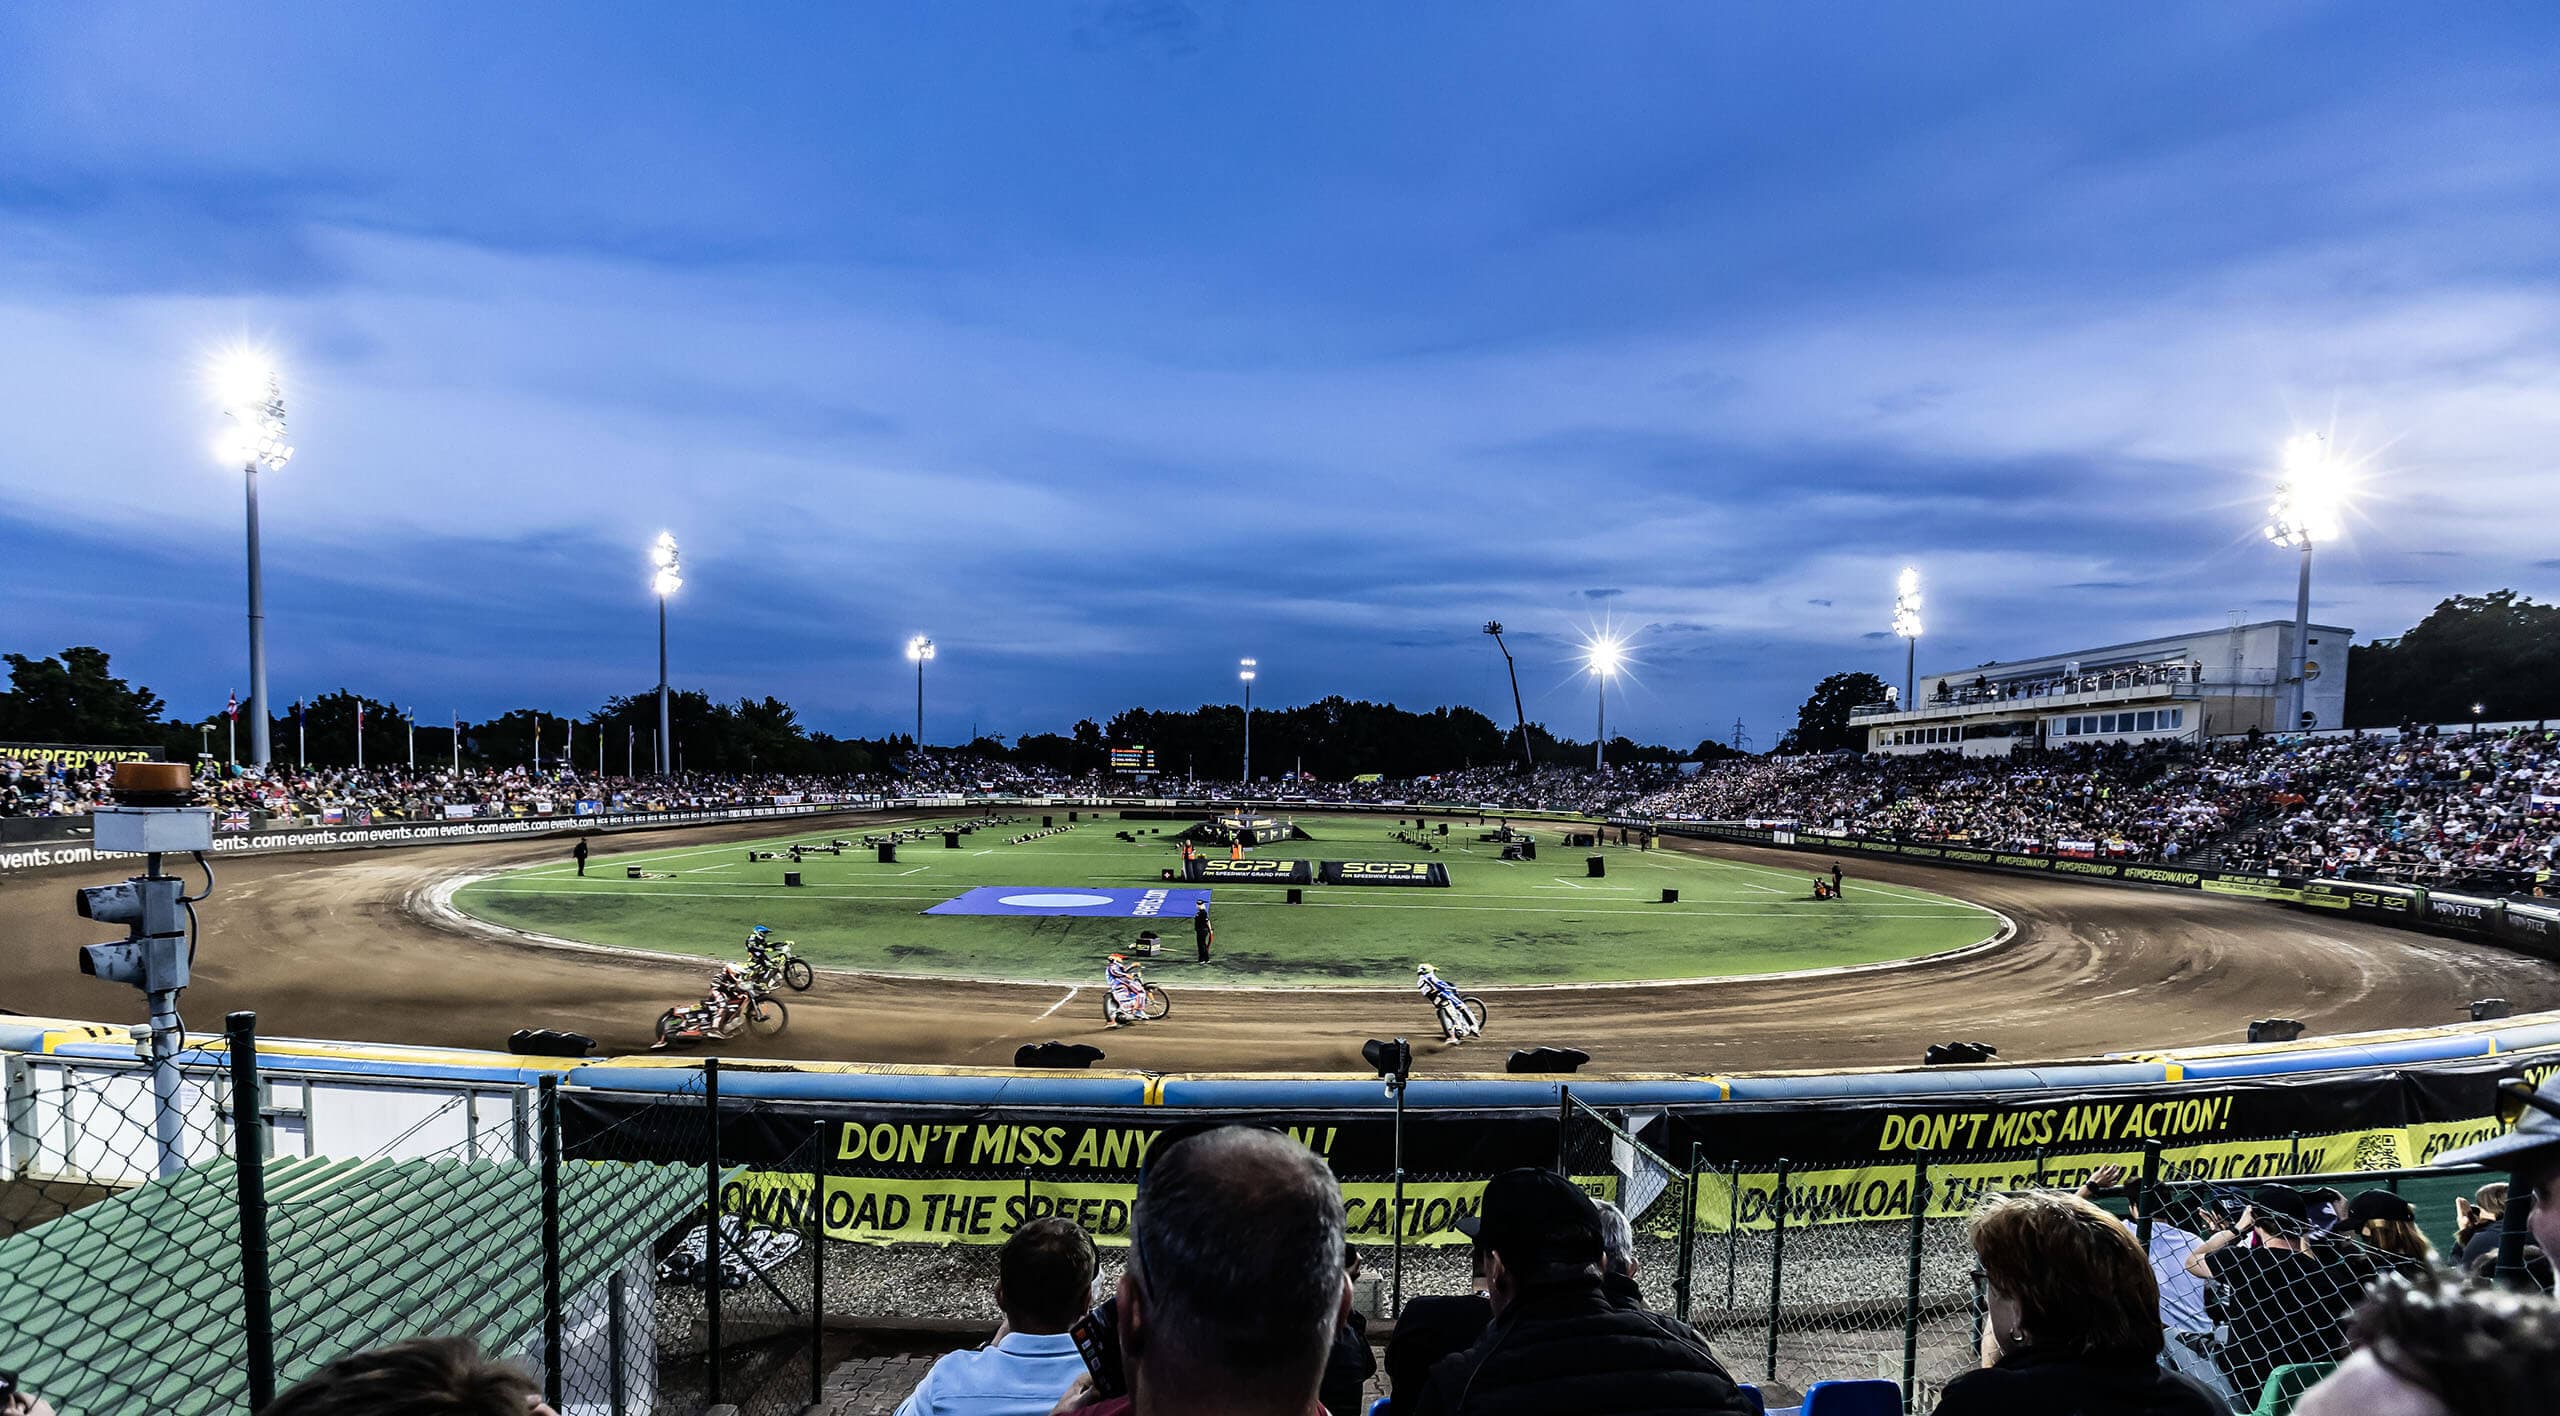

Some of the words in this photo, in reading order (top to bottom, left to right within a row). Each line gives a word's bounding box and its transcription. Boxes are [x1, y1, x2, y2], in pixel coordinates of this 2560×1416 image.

[213, 835, 286, 851] ents.com
[288, 831, 370, 847] events.com
[370, 827, 439, 842] events.com
[440, 823, 499, 837] events.com
[499, 820, 550, 833] events.com
[1204, 860, 1277, 872] SGP
[1342, 862, 1412, 874] SGP
[2124, 867, 2199, 884] #FIMSPEEDWAYGP
[2432, 901, 2482, 920] MONSTER
[2508, 914, 2547, 934] MONSTER
[1879, 1112, 1988, 1151] DON'T
[1988, 1108, 2058, 1149] MISS
[2057, 1105, 2121, 1145] ANY
[837, 1121, 967, 1164] DON'T
[970, 1124, 1066, 1167] MISS
[1069, 1127, 1161, 1169] ANY
[923, 1193, 995, 1235] THE
[1001, 1196, 1129, 1238] SPEED
[1344, 1197, 1483, 1236] CATION
